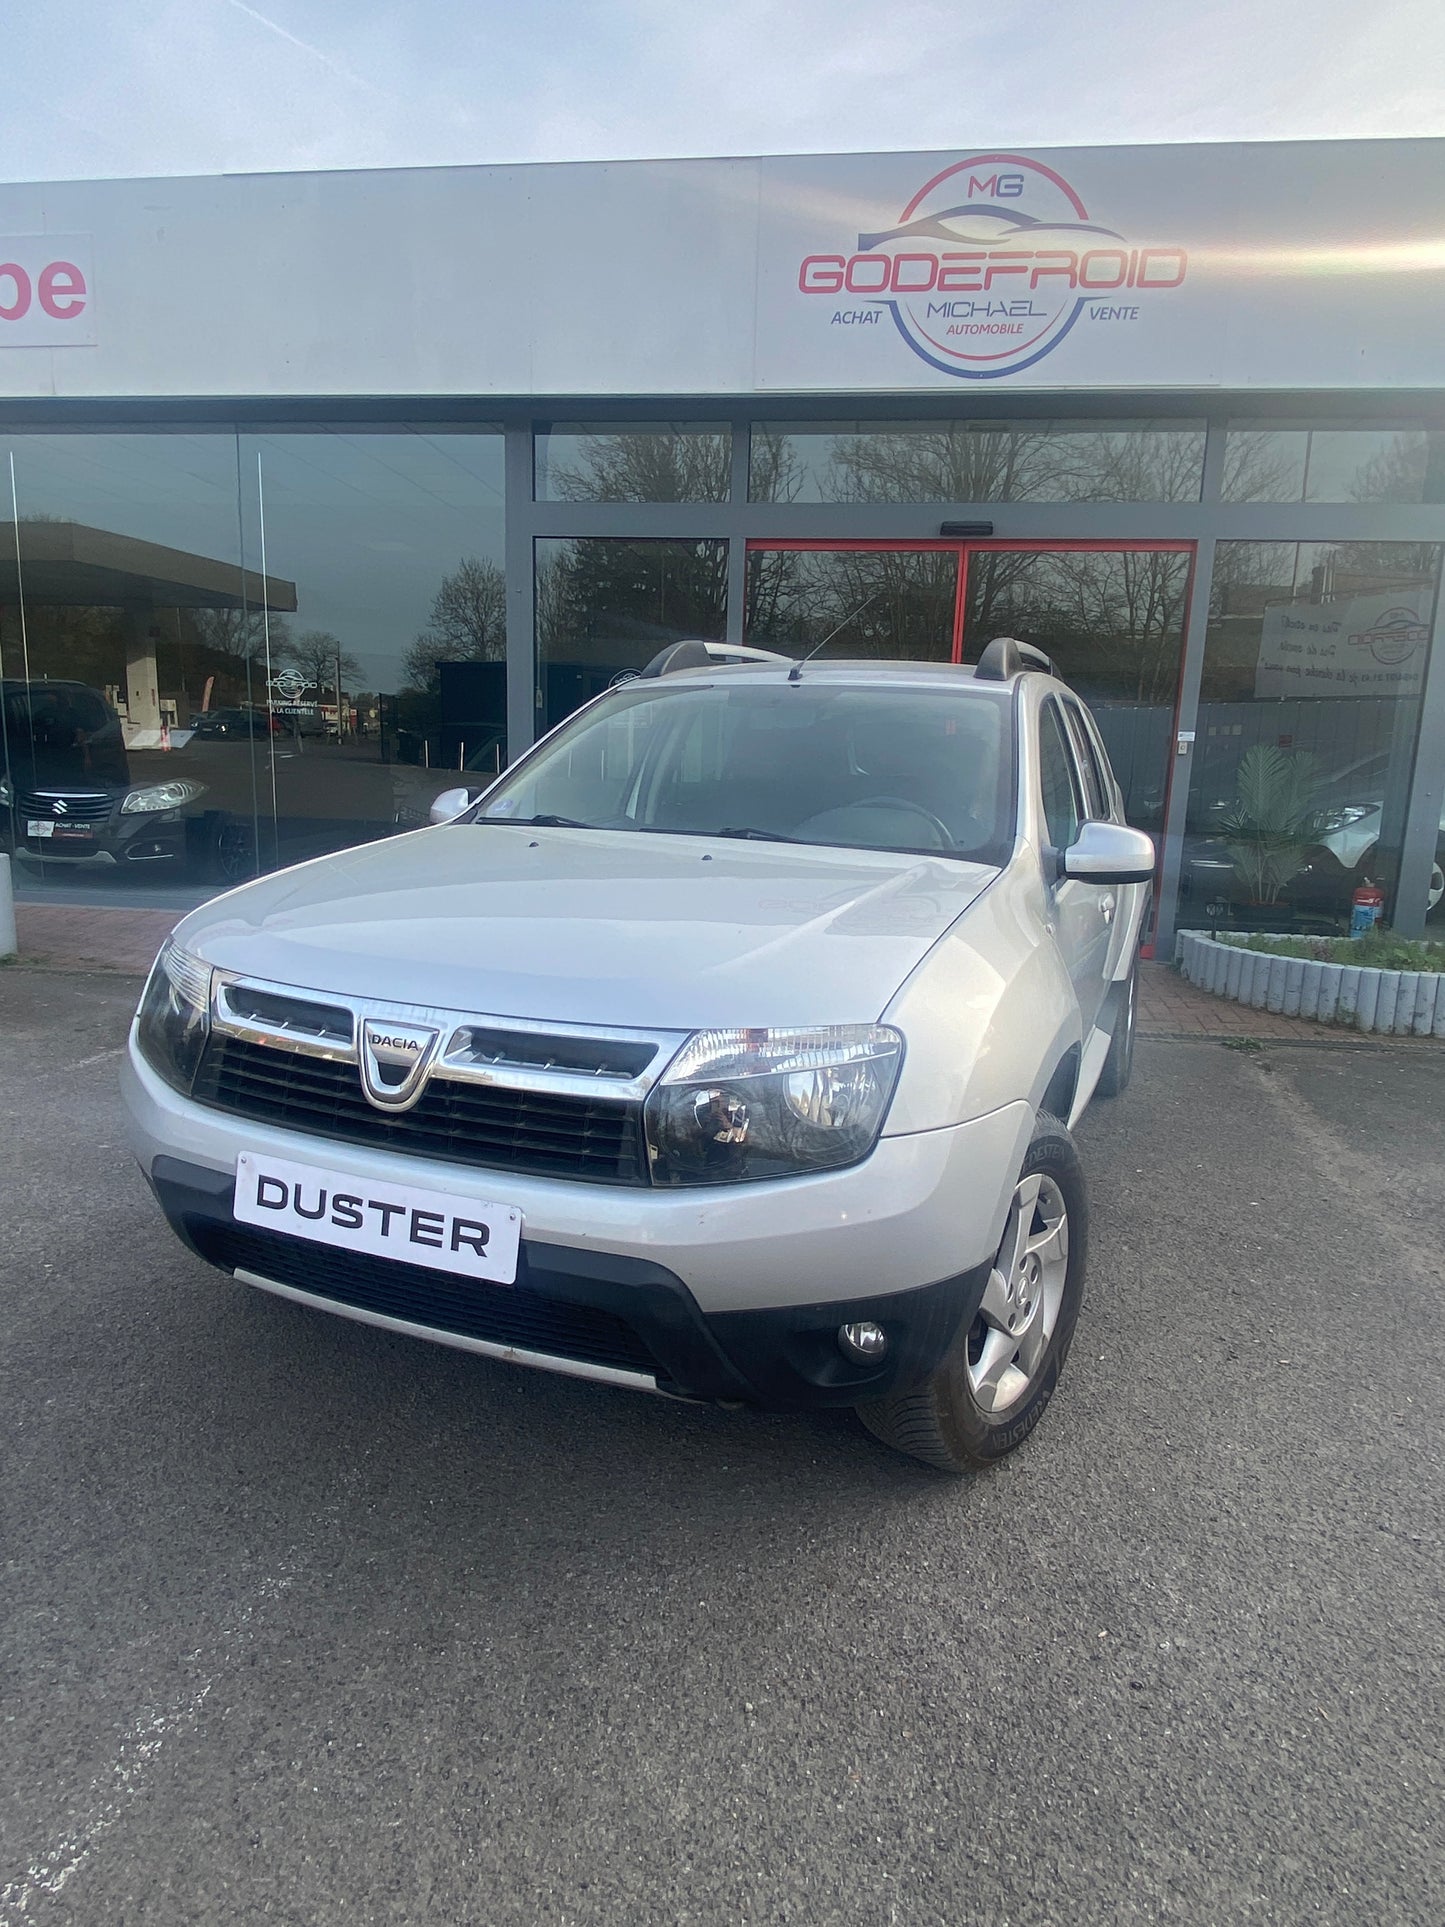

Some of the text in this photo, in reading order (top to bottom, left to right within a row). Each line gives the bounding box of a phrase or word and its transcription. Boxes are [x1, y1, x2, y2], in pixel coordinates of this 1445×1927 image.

[967, 174, 1024, 198] MG
[798, 248, 1188, 294] GODEFROID
[831, 309, 883, 325] ACHAT
[926, 299, 1047, 319] MICHAEL
[1090, 306, 1140, 321] VENTE
[946, 322, 1024, 336] AUTOMOBILE
[371, 1034, 419, 1051] DACIA
[256, 1174, 490, 1258] DUSTER
